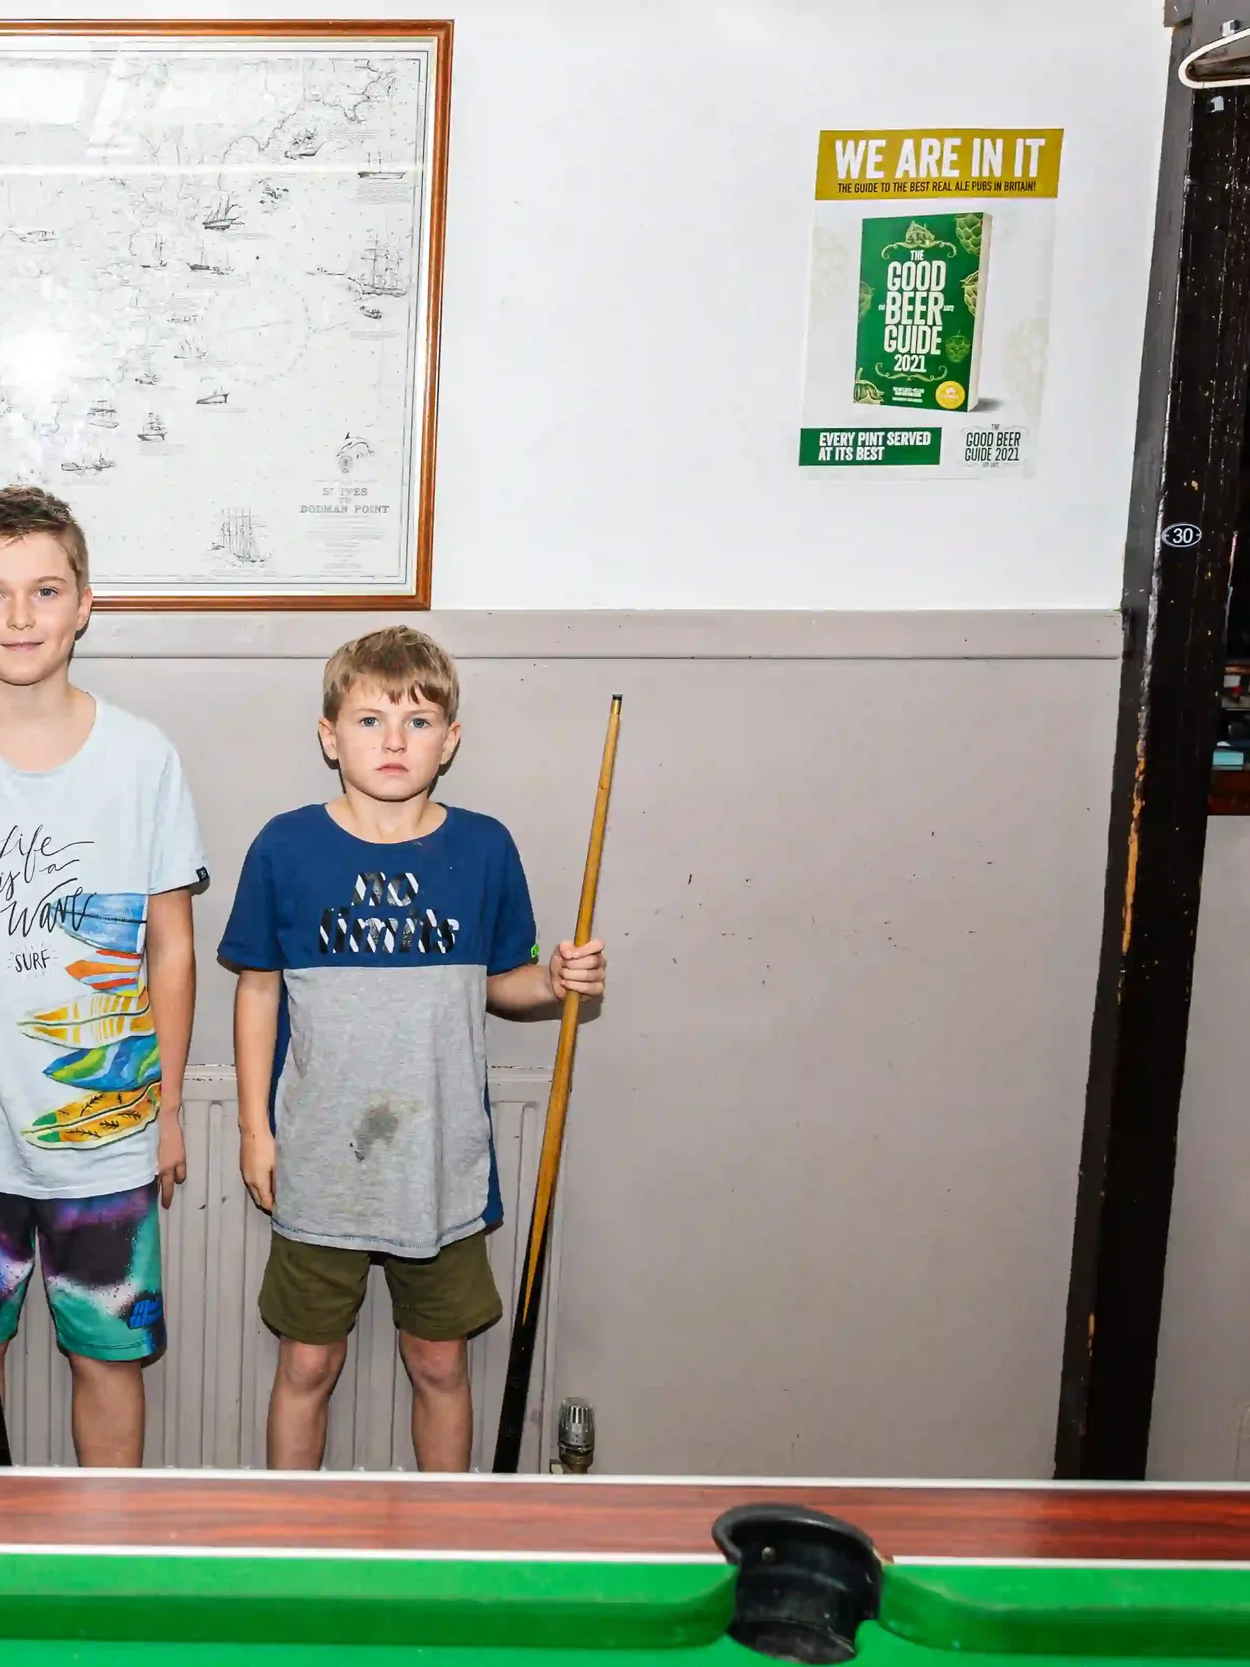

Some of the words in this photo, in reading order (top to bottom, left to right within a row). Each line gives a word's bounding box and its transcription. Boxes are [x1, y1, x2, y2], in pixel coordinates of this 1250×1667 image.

[835, 139, 886, 179] WE
[895, 138, 962, 179] ARE
[971, 138, 1003, 178] IN
[1014, 138, 1046, 178] IT
[838, 183, 852, 193] THE
[854, 182, 878, 193] GUIDE
[881, 182, 890, 192] TO
[893, 182, 907, 192] THE
[910, 181, 930, 192] BEST
[932, 181, 952, 191] REAL
[954, 181, 969, 191] ALE
[971, 181, 992, 191] PUBS
[994, 181, 1002, 191] IN
[1004, 181, 1036, 192] BRITAIN!
[910, 250, 924, 261] THE
[887, 260, 947, 292] GOOD
[885, 291, 945, 325] BEER
[884, 325, 943, 354] GUIDE
[894, 354, 927, 373] 2021
[819, 432, 855, 446] EVERY
[858, 432, 885, 446] PINT
[887, 431, 931, 446] SERVED
[966, 432, 994, 446] GOOD
[996, 431, 1021, 446] BEER
[818, 447, 833, 461] AT
[835, 447, 853, 461] ITS
[856, 446, 885, 461] BEST
[964, 447, 992, 461] GUIDE
[995, 447, 1020, 461] 2021
[300, 505, 348, 513] DODMAN
[354, 505, 390, 513] POINT
[1172, 527, 1194, 544] 30
[14, 949, 50, 973] SURF
